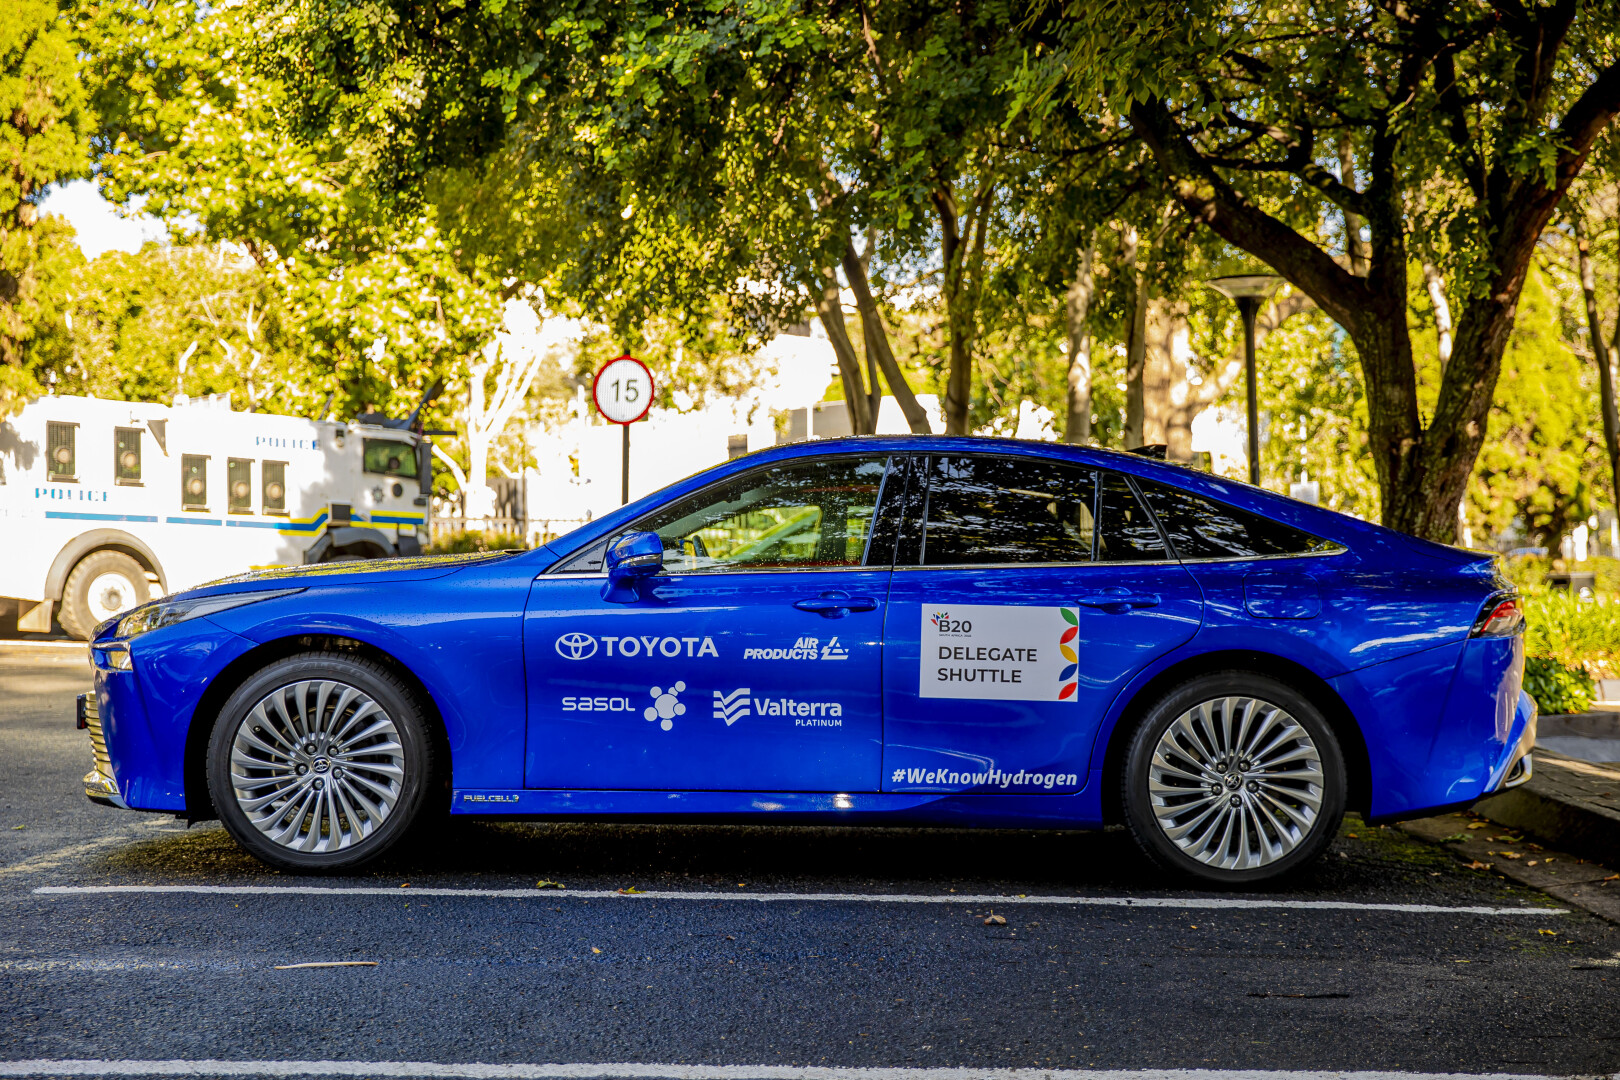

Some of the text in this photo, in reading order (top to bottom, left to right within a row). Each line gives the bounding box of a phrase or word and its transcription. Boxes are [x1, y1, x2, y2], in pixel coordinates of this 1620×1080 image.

[611, 379, 639, 402] 15
[939, 620, 972, 633] B20
[601, 636, 719, 657] TOYOTA
[793, 637, 819, 649] AIR
[743, 648, 818, 660] PRODUCTS
[938, 646, 1038, 662] DELEGATE
[937, 668, 1022, 683] SHUTTLE
[753, 698, 842, 716] Valterra
[795, 719, 842, 727] PLATINUM
[891, 768, 1078, 789] #WeKnowHydrogen
